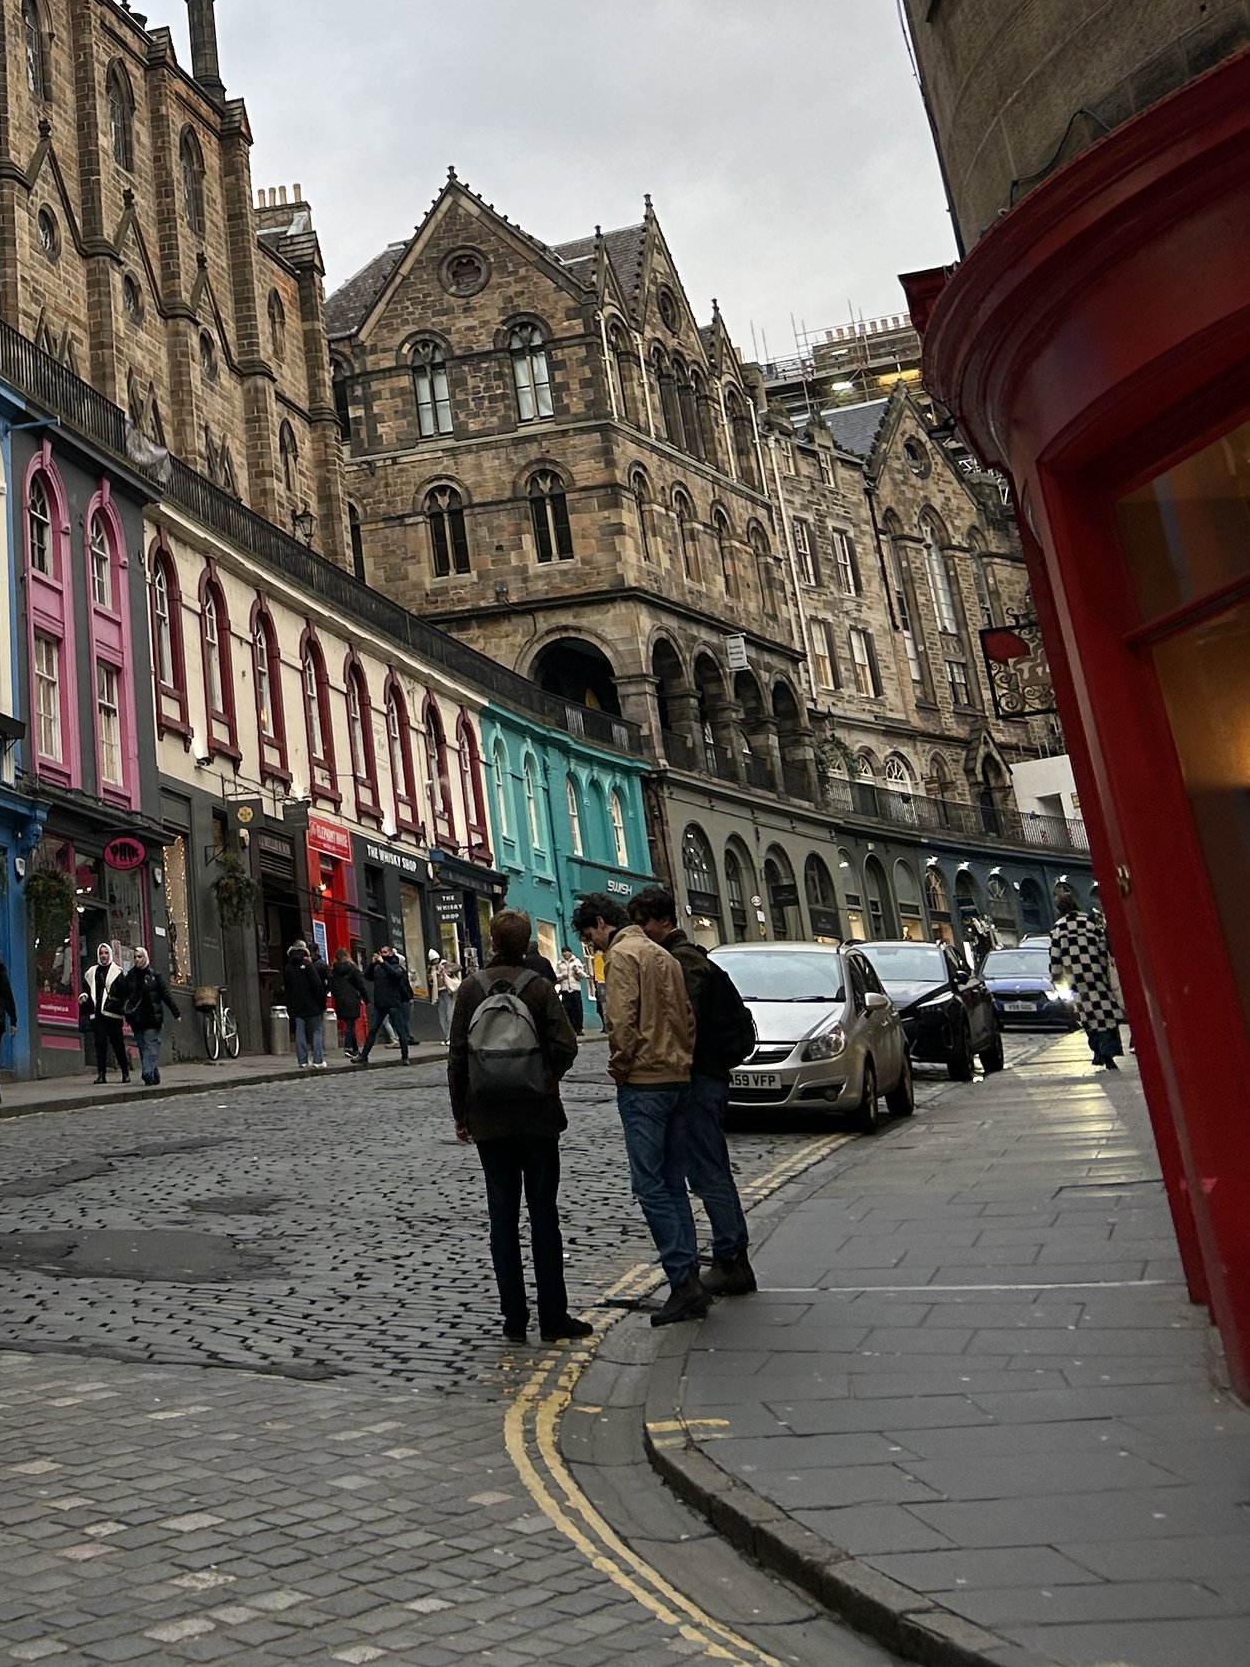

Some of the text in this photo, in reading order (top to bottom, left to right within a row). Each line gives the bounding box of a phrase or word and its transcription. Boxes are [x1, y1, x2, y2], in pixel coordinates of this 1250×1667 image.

[366, 844, 417, 872] THE WHISKY SHOP
[753, 1075, 775, 1087] VFP
